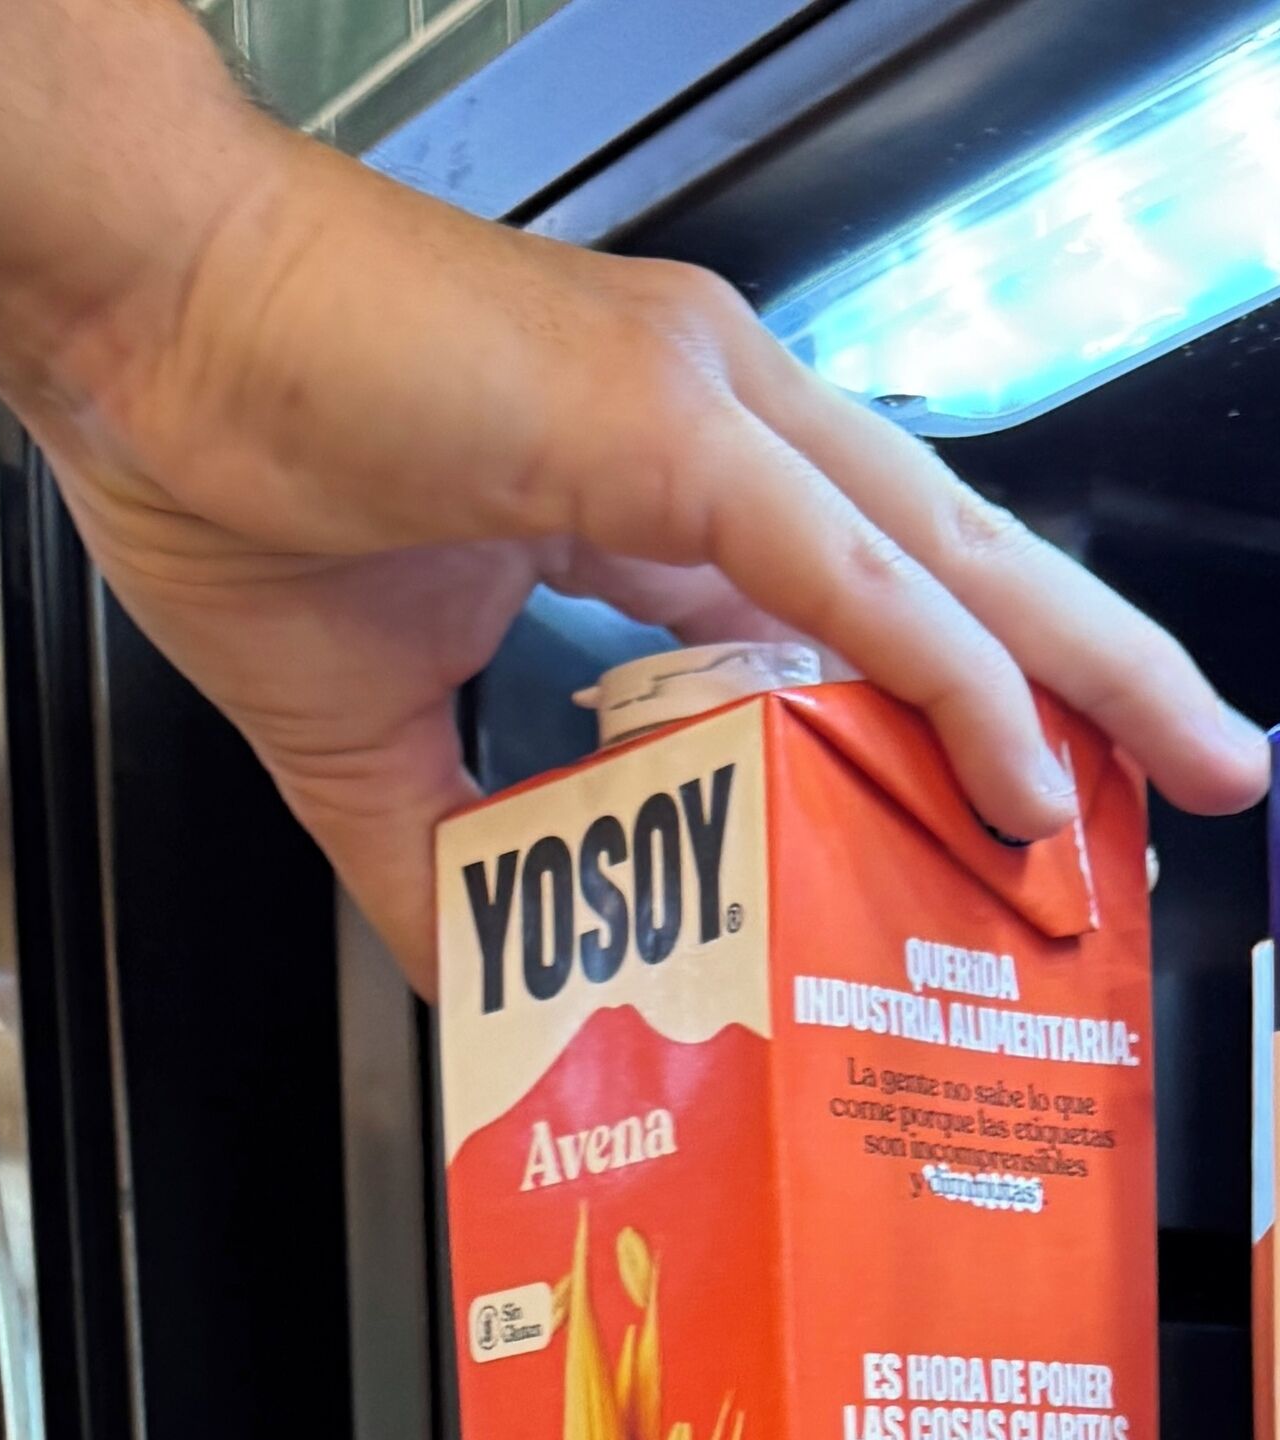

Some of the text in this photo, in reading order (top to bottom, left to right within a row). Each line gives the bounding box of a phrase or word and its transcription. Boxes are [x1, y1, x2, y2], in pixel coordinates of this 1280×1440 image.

[793, 975, 1140, 1066] INDUSTRIA ALIMENTARIA:
[829, 1098, 896, 1122] come
[899, 1104, 974, 1138] porque
[977, 1109, 1010, 1138] las
[847, 1057, 876, 1087] La
[943, 1081, 970, 1101] no
[974, 1080, 1024, 1108] sabe
[1027, 1084, 1049, 1111] lo
[1054, 1094, 1096, 1120] que
[519, 1108, 678, 1192] Avena
[864, 1134, 906, 1158] son
[863, 1352, 1114, 1409] ES HORA DE PONER
